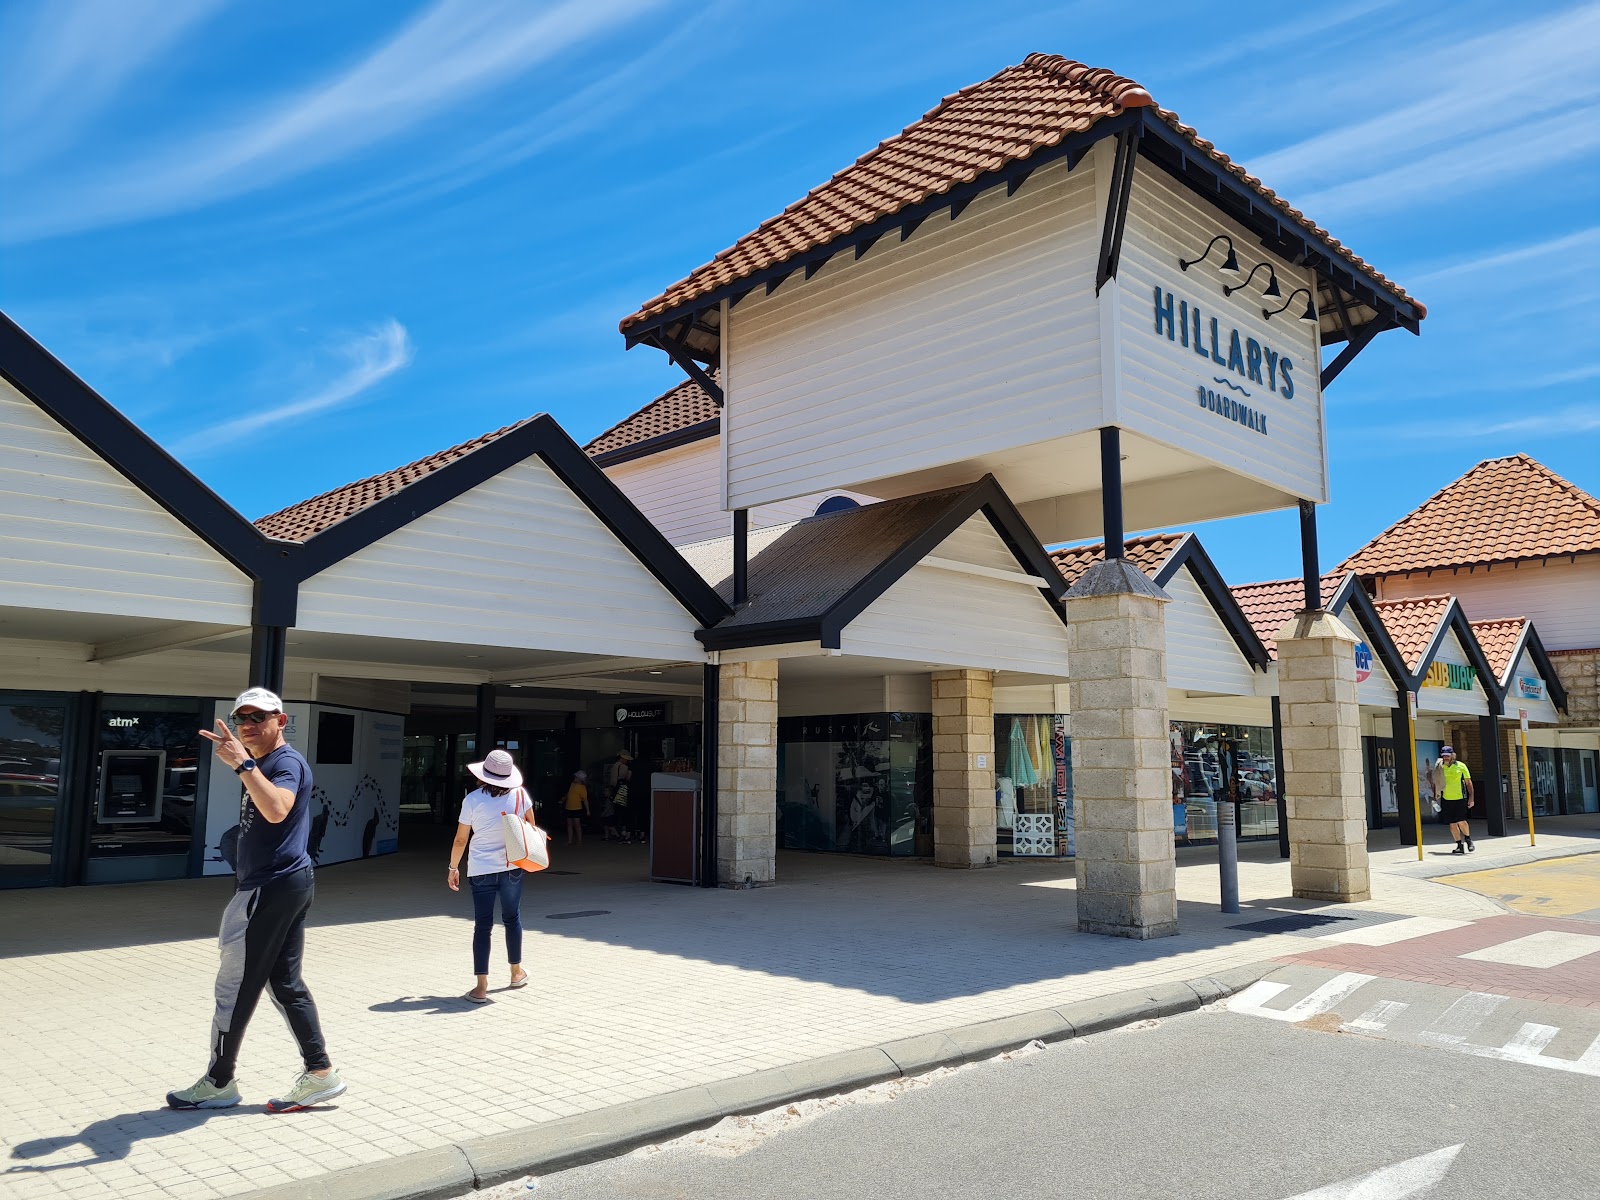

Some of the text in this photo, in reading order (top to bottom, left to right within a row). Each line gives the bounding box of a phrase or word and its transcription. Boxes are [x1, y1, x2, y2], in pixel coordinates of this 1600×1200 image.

[1154, 285, 1295, 400] HILLARYS
[1199, 385, 1268, 436] BOARDWALK
[1421, 661, 1477, 691] SUBWAY
[108, 716, 139, 727] atmx
[802, 725, 858, 735] RUSTY
